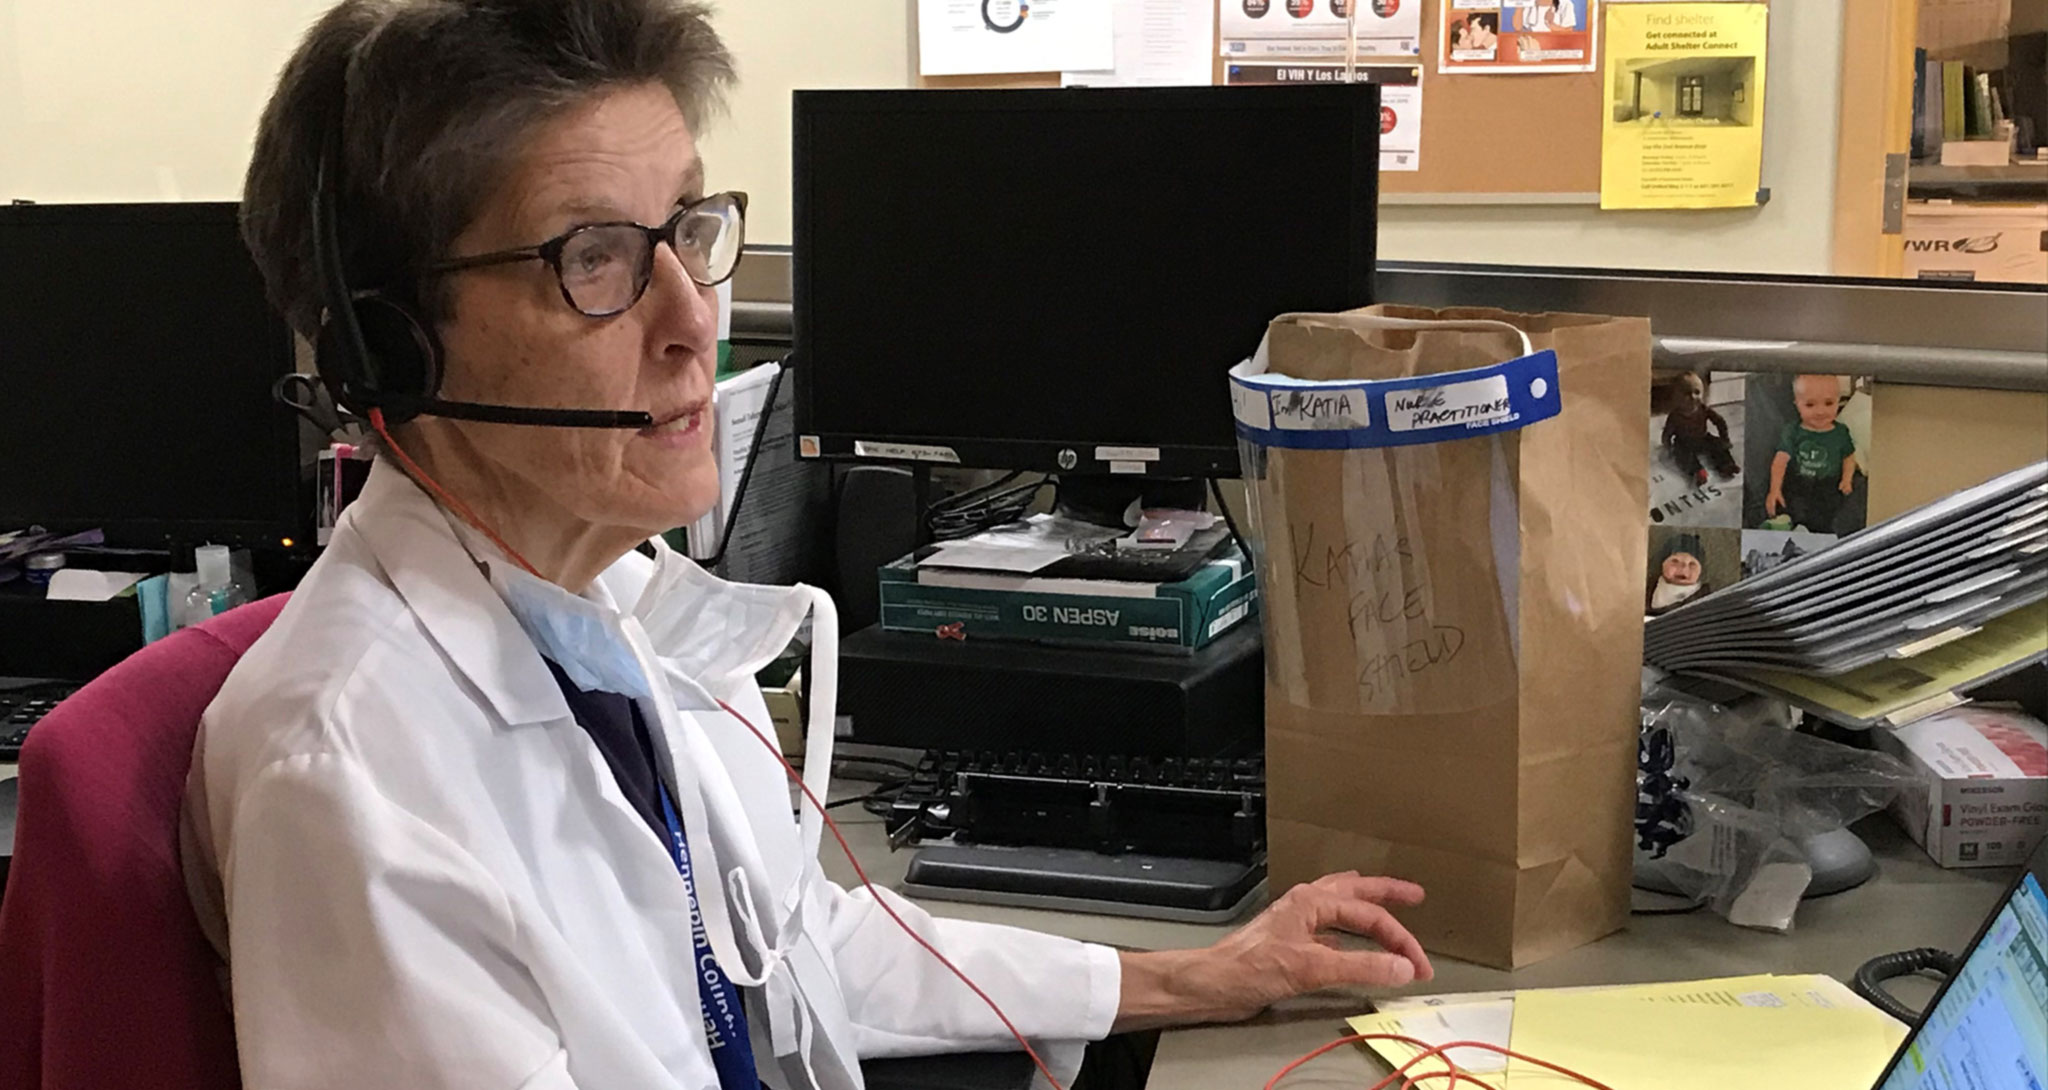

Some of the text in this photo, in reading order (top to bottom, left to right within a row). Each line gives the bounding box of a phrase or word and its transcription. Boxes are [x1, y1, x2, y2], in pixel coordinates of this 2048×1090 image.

[1646, 14, 1715, 25] Find shelter
[1646, 31, 1661, 39] Get
[1662, 31, 1707, 39] connected
[1646, 41, 1738, 50] Adult Shelter Connect
[1277, 69, 1287, 80] El
[1306, 69, 1314, 81] Y
[1315, 69, 1332, 81] Los
[1334, 70, 1369, 82] Laos
[1300, 393, 1352, 421] KATIA
[1411, 398, 1511, 428] PRACTITIONER
[1649, 485, 1722, 523] ONTHS
[1022, 605, 1120, 627] ASPEN 30
[1348, 582, 1425, 641] FACE
[1359, 625, 1465, 702] SHIELD
[1960, 803, 1988, 815] Vinyl
[1989, 803, 2021, 813] Exam
[1960, 816, 2040, 827] POWDER-FREE
